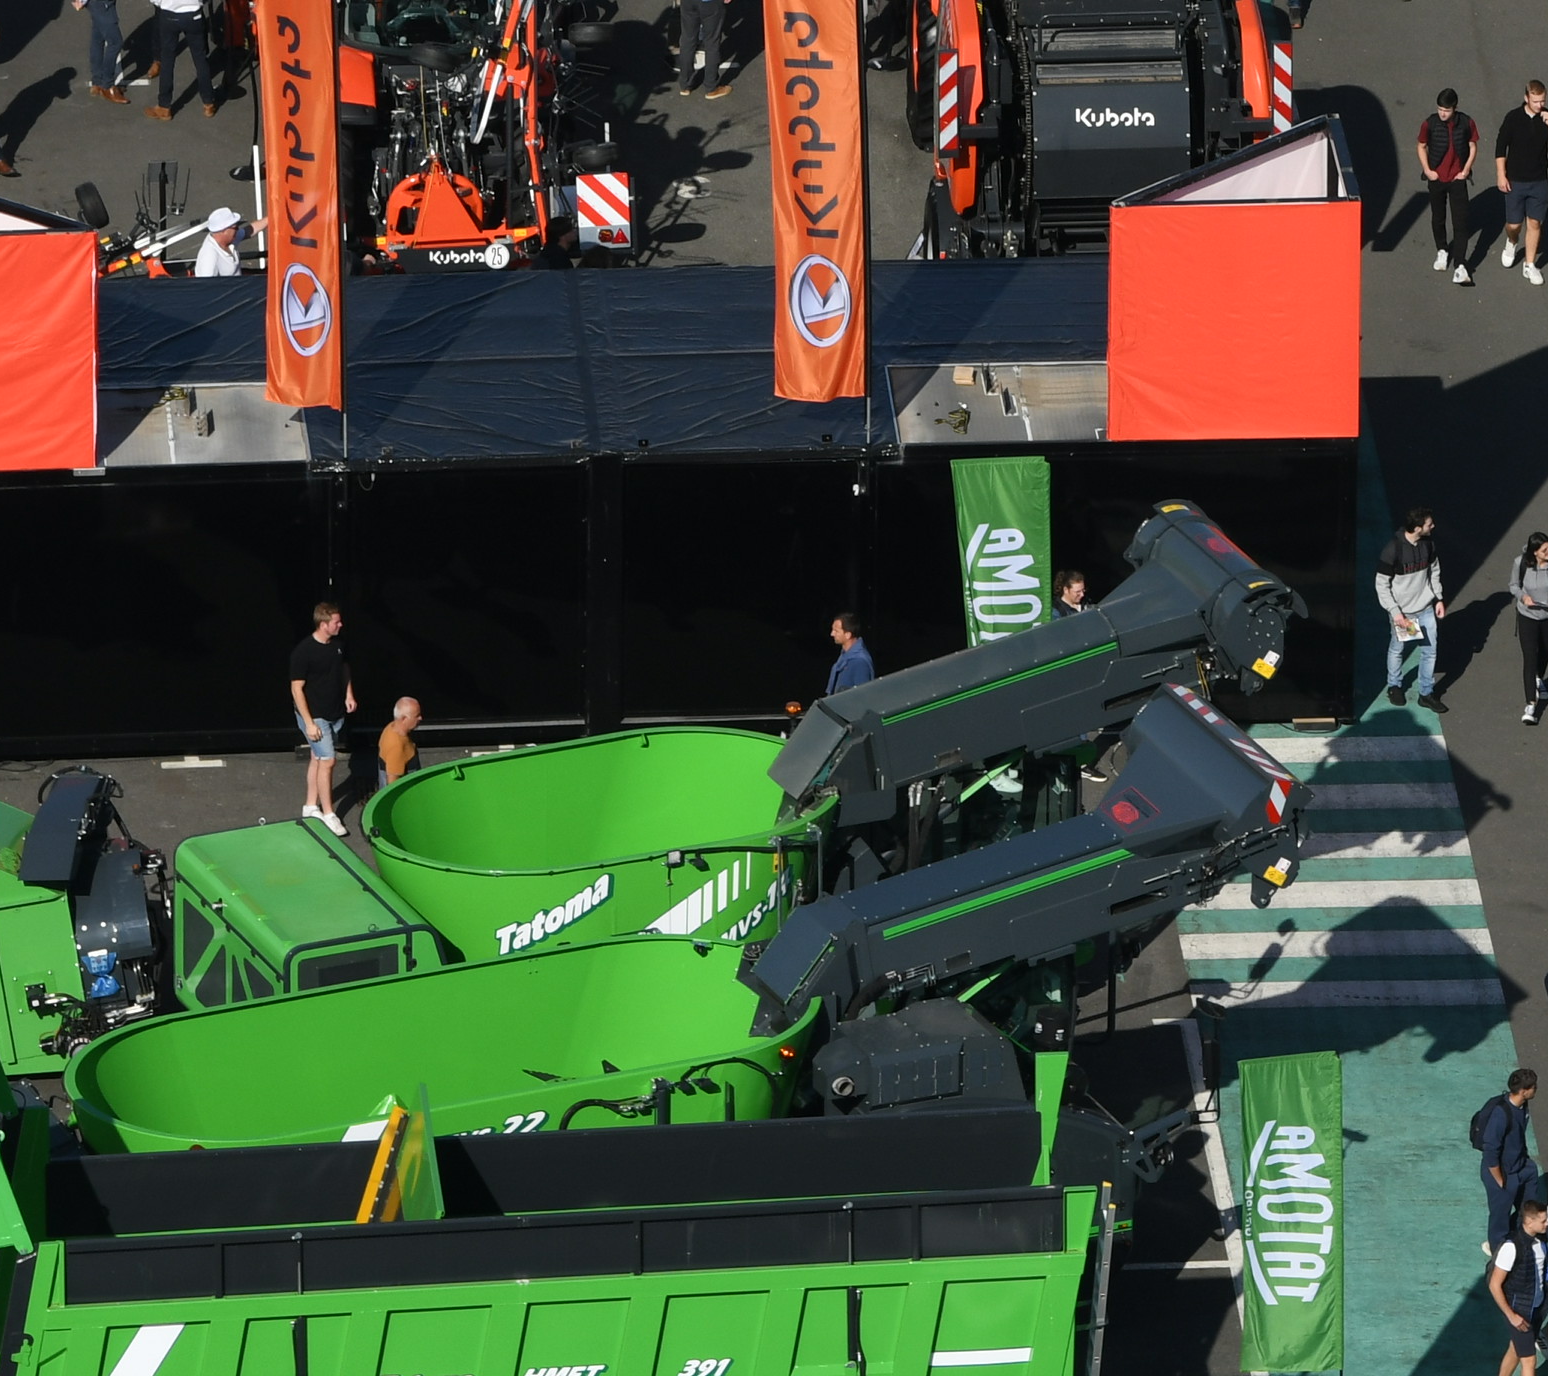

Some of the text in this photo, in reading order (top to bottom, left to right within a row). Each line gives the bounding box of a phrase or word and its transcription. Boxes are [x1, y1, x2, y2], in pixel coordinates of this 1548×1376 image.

[1074, 107, 1155, 128] Kubota
[428, 247, 503, 265] Kubota 25
[495, 873, 611, 957] Tatoma
